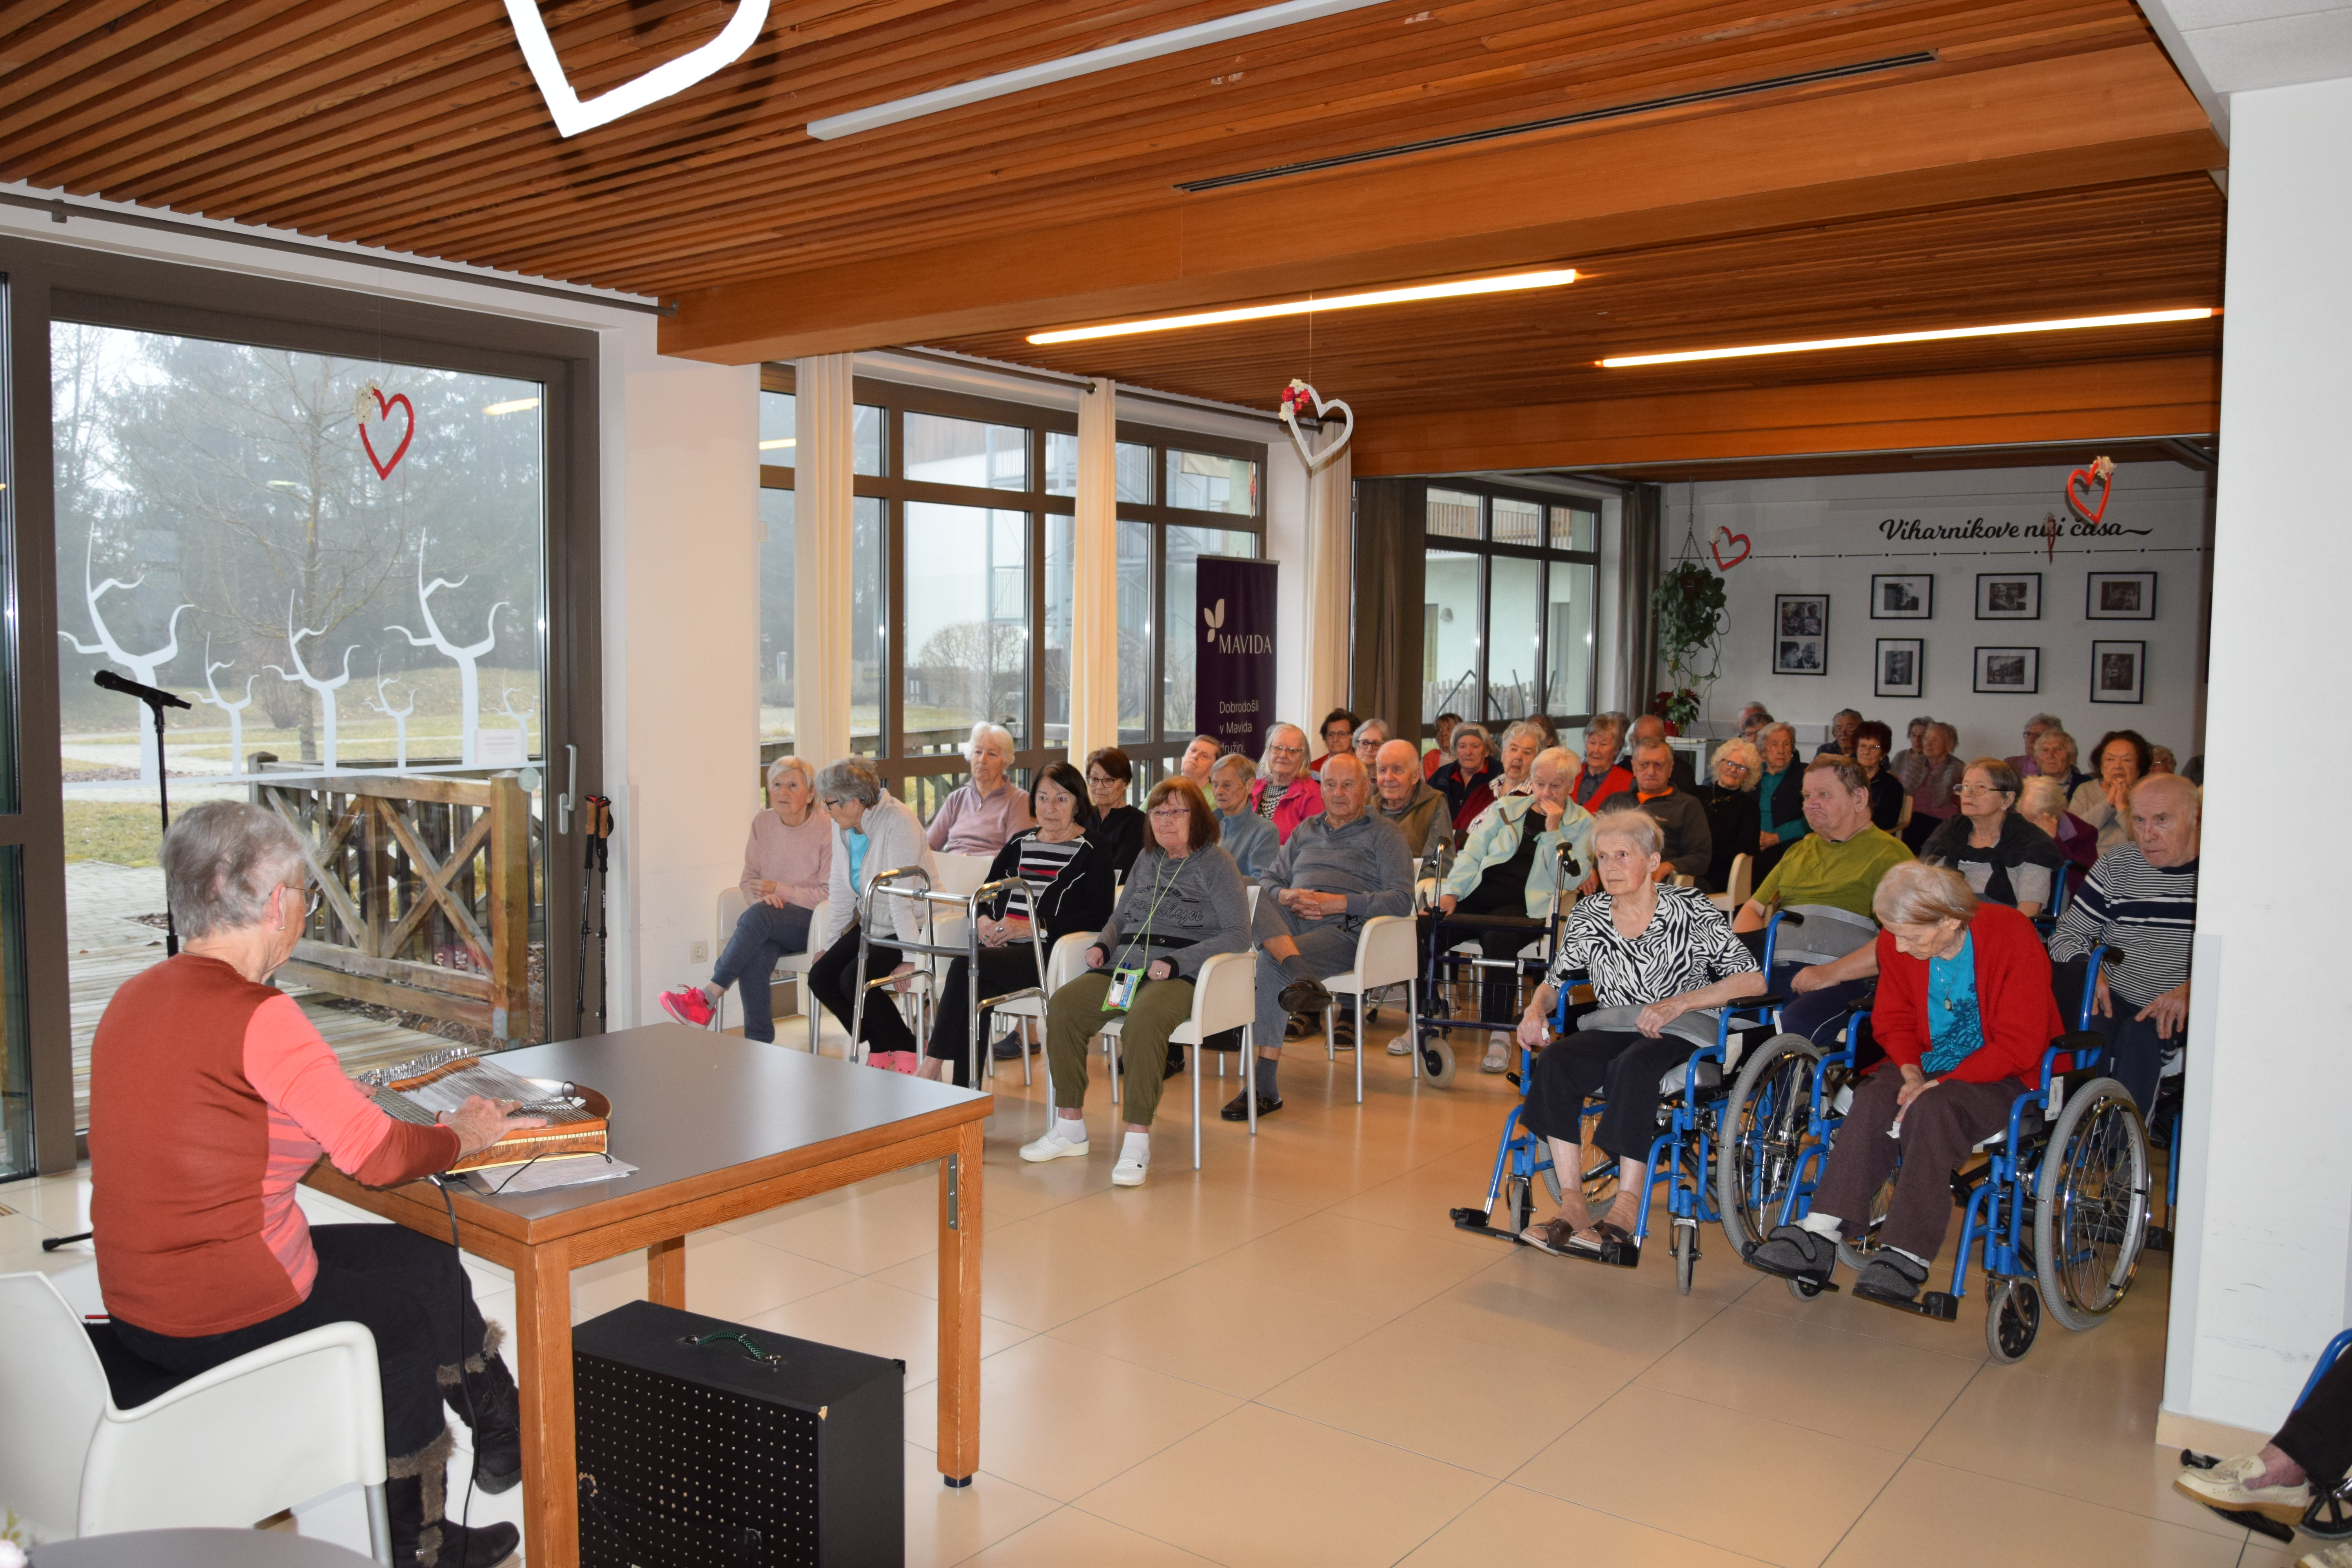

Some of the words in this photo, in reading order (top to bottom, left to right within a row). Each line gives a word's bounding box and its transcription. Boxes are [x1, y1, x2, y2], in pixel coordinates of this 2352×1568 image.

[1879, 517, 2020, 540] Viharnikove
[2024, 517, 2064, 537] nii
[1220, 634, 1272, 654] MAVIDA
[1220, 699, 1259, 714] Dobrodošli
[1220, 724, 1224, 734] v
[1226, 721, 1252, 734] Mavida
